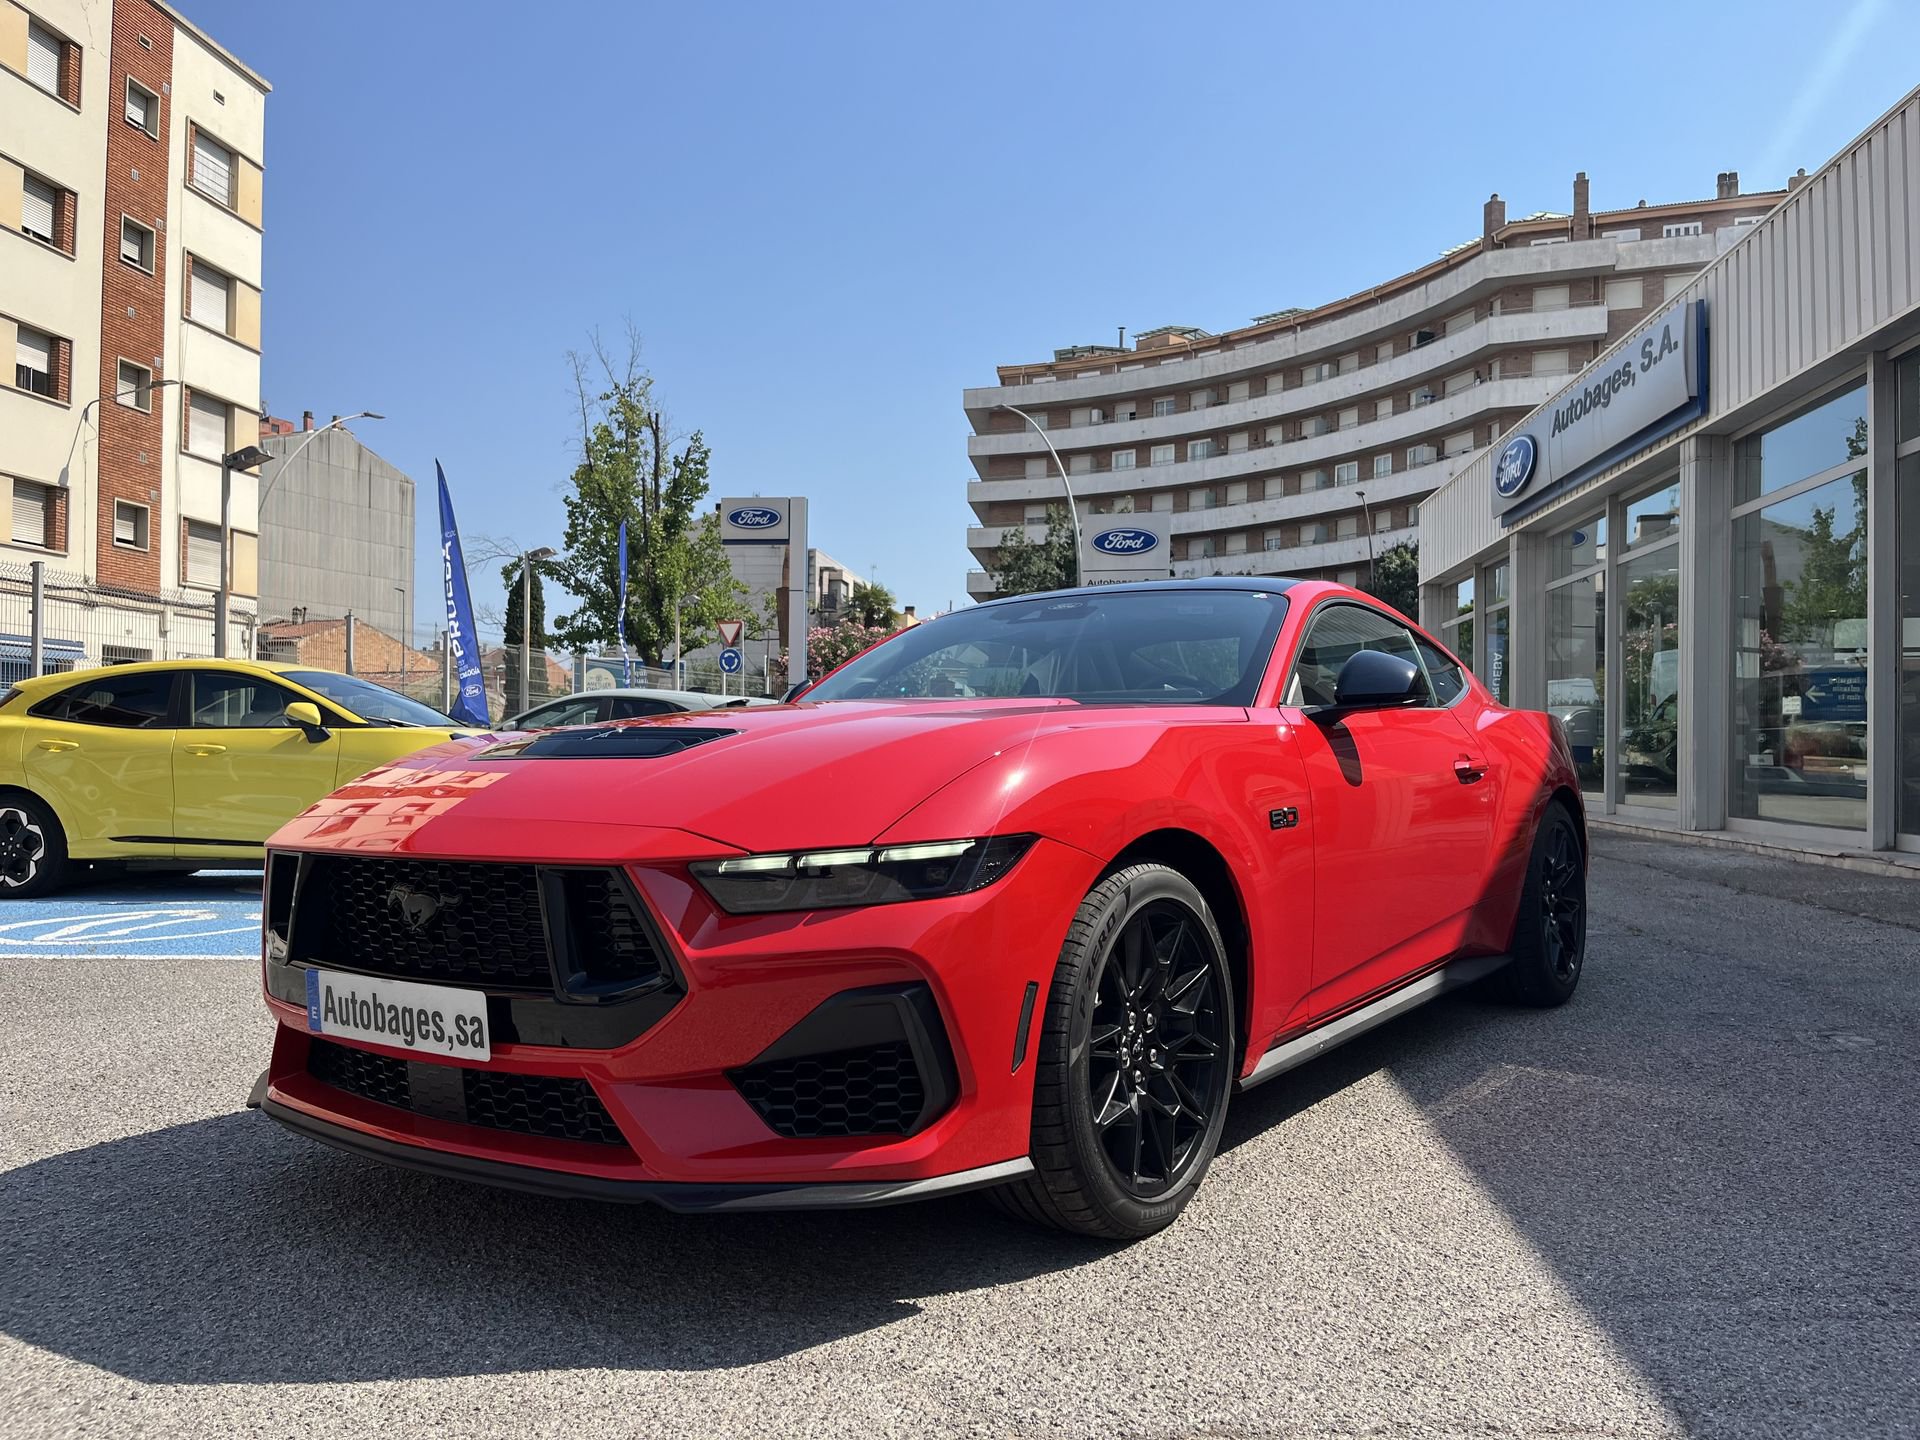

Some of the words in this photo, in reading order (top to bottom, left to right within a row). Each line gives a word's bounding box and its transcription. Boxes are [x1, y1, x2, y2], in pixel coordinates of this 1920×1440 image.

[1551, 360, 1636, 438] Autobages,
[1640, 324, 1679, 373] S.A.
[1499, 447, 1522, 488] Ford
[738, 510, 770, 525] Ford
[1104, 532, 1145, 549] Ford
[1085, 912, 1117, 991] ZERO
[311, 1006, 318, 1020] E
[324, 985, 485, 1051] Autobages,sa
